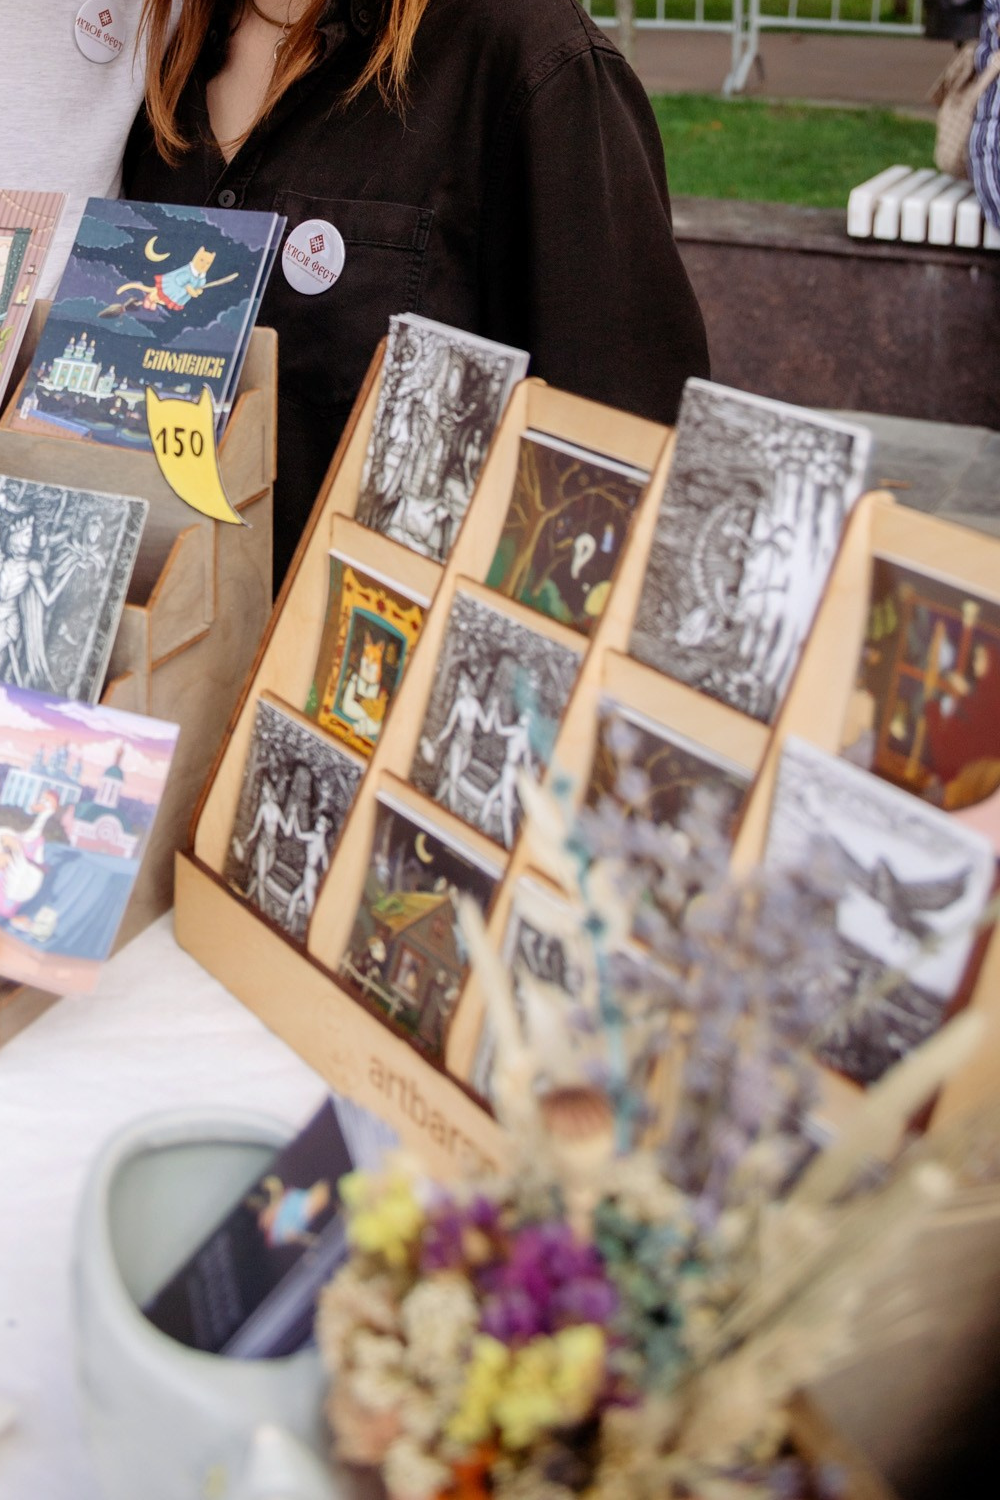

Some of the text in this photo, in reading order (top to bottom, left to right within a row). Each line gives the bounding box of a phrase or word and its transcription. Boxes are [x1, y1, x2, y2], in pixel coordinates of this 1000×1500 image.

[311, 260, 338, 284] ФЕСТ
[142, 348, 226, 379] СМОЛЕНСК
[156, 427, 204, 457] 150
